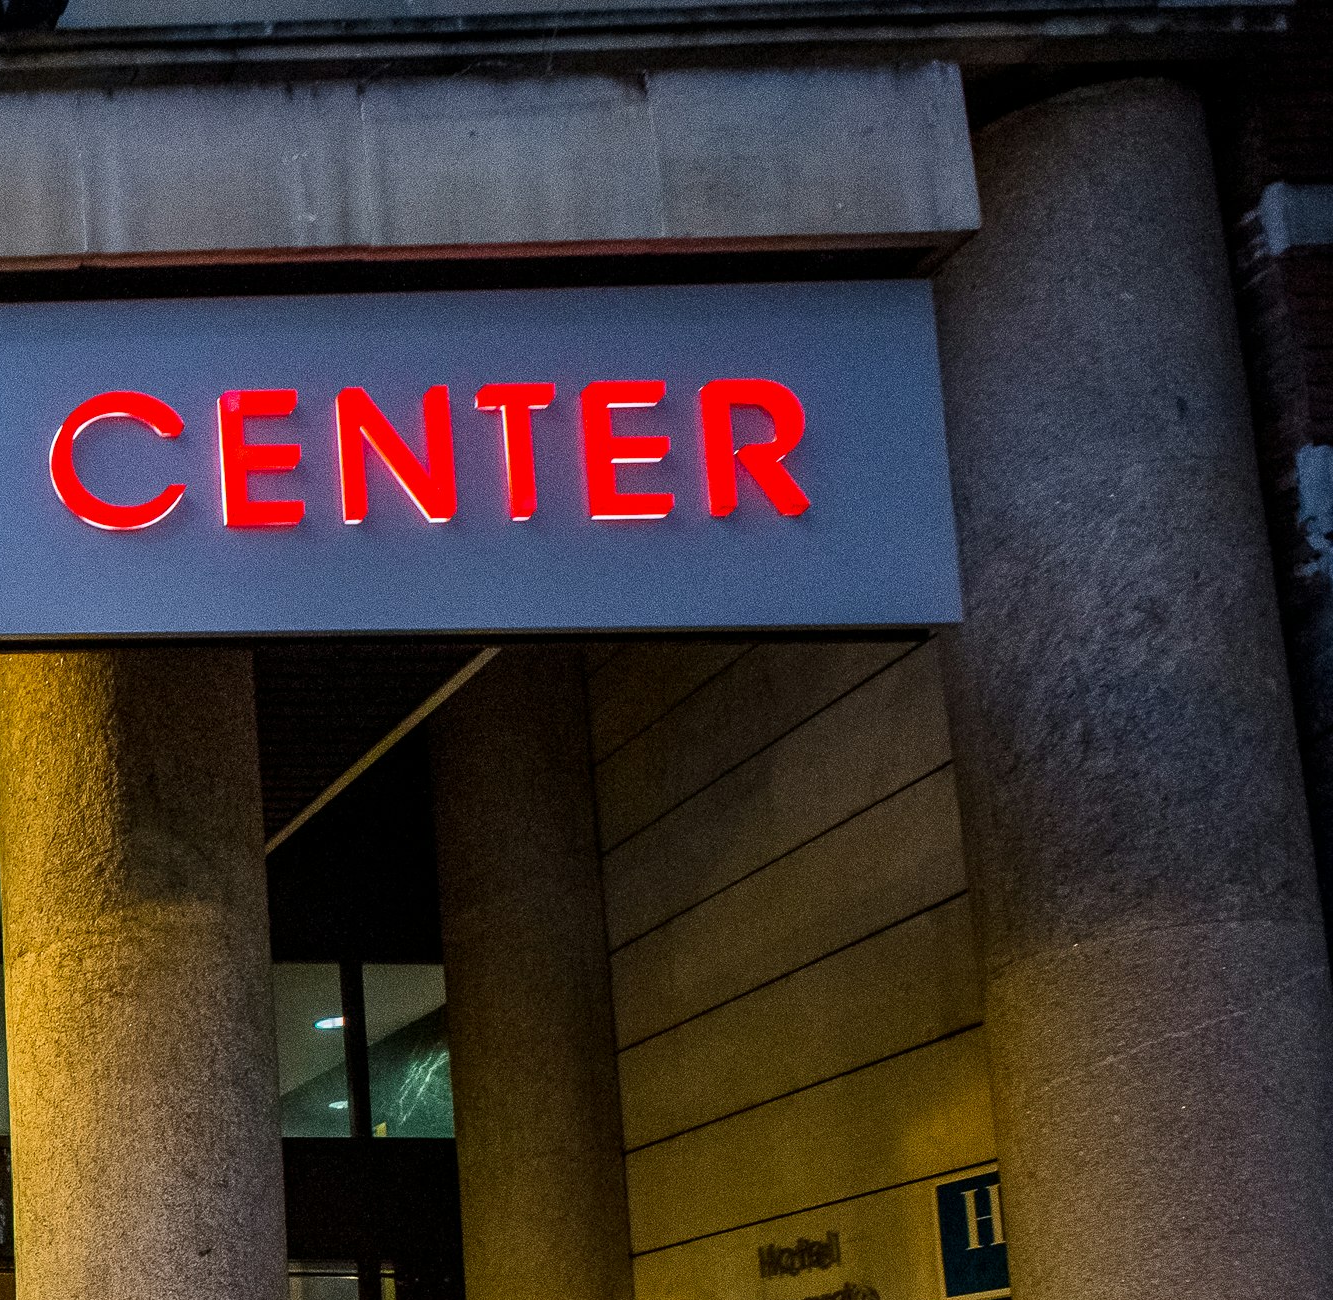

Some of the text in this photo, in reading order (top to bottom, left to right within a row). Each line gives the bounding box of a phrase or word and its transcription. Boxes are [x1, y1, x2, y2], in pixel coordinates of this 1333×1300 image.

[49, 378, 812, 533] CENTER
[960, 1183, 1006, 1251] H
[758, 1231, 841, 1278] Hotel
